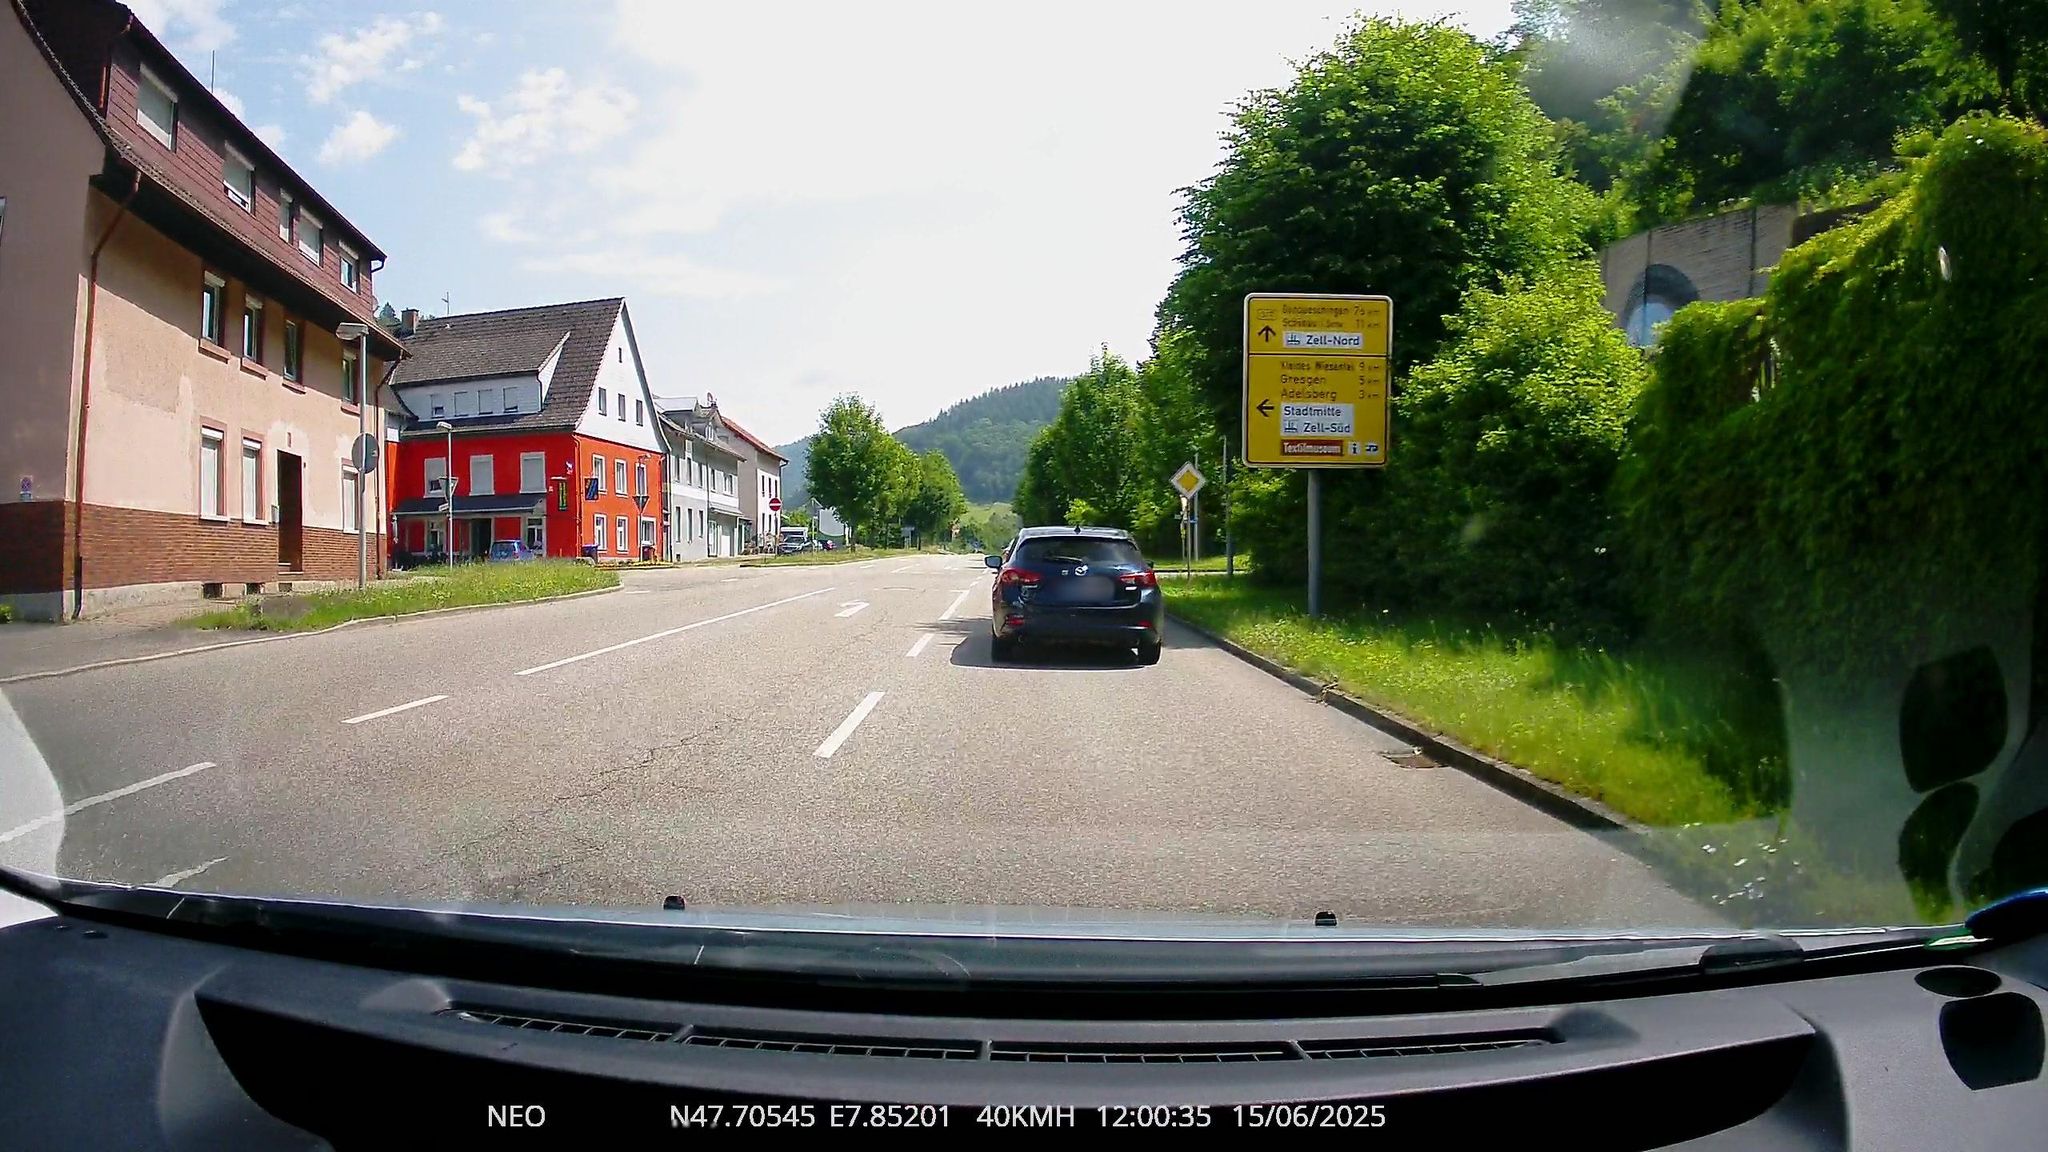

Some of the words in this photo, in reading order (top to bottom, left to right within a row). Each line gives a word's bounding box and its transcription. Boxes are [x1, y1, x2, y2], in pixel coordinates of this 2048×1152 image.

[1306, 335, 1360, 346] Zell-Nord
[1281, 374, 1326, 386] Gresgen
[1284, 405, 1341, 417] Stadtmitte
[1303, 422, 1351, 433] Zell-Süd
